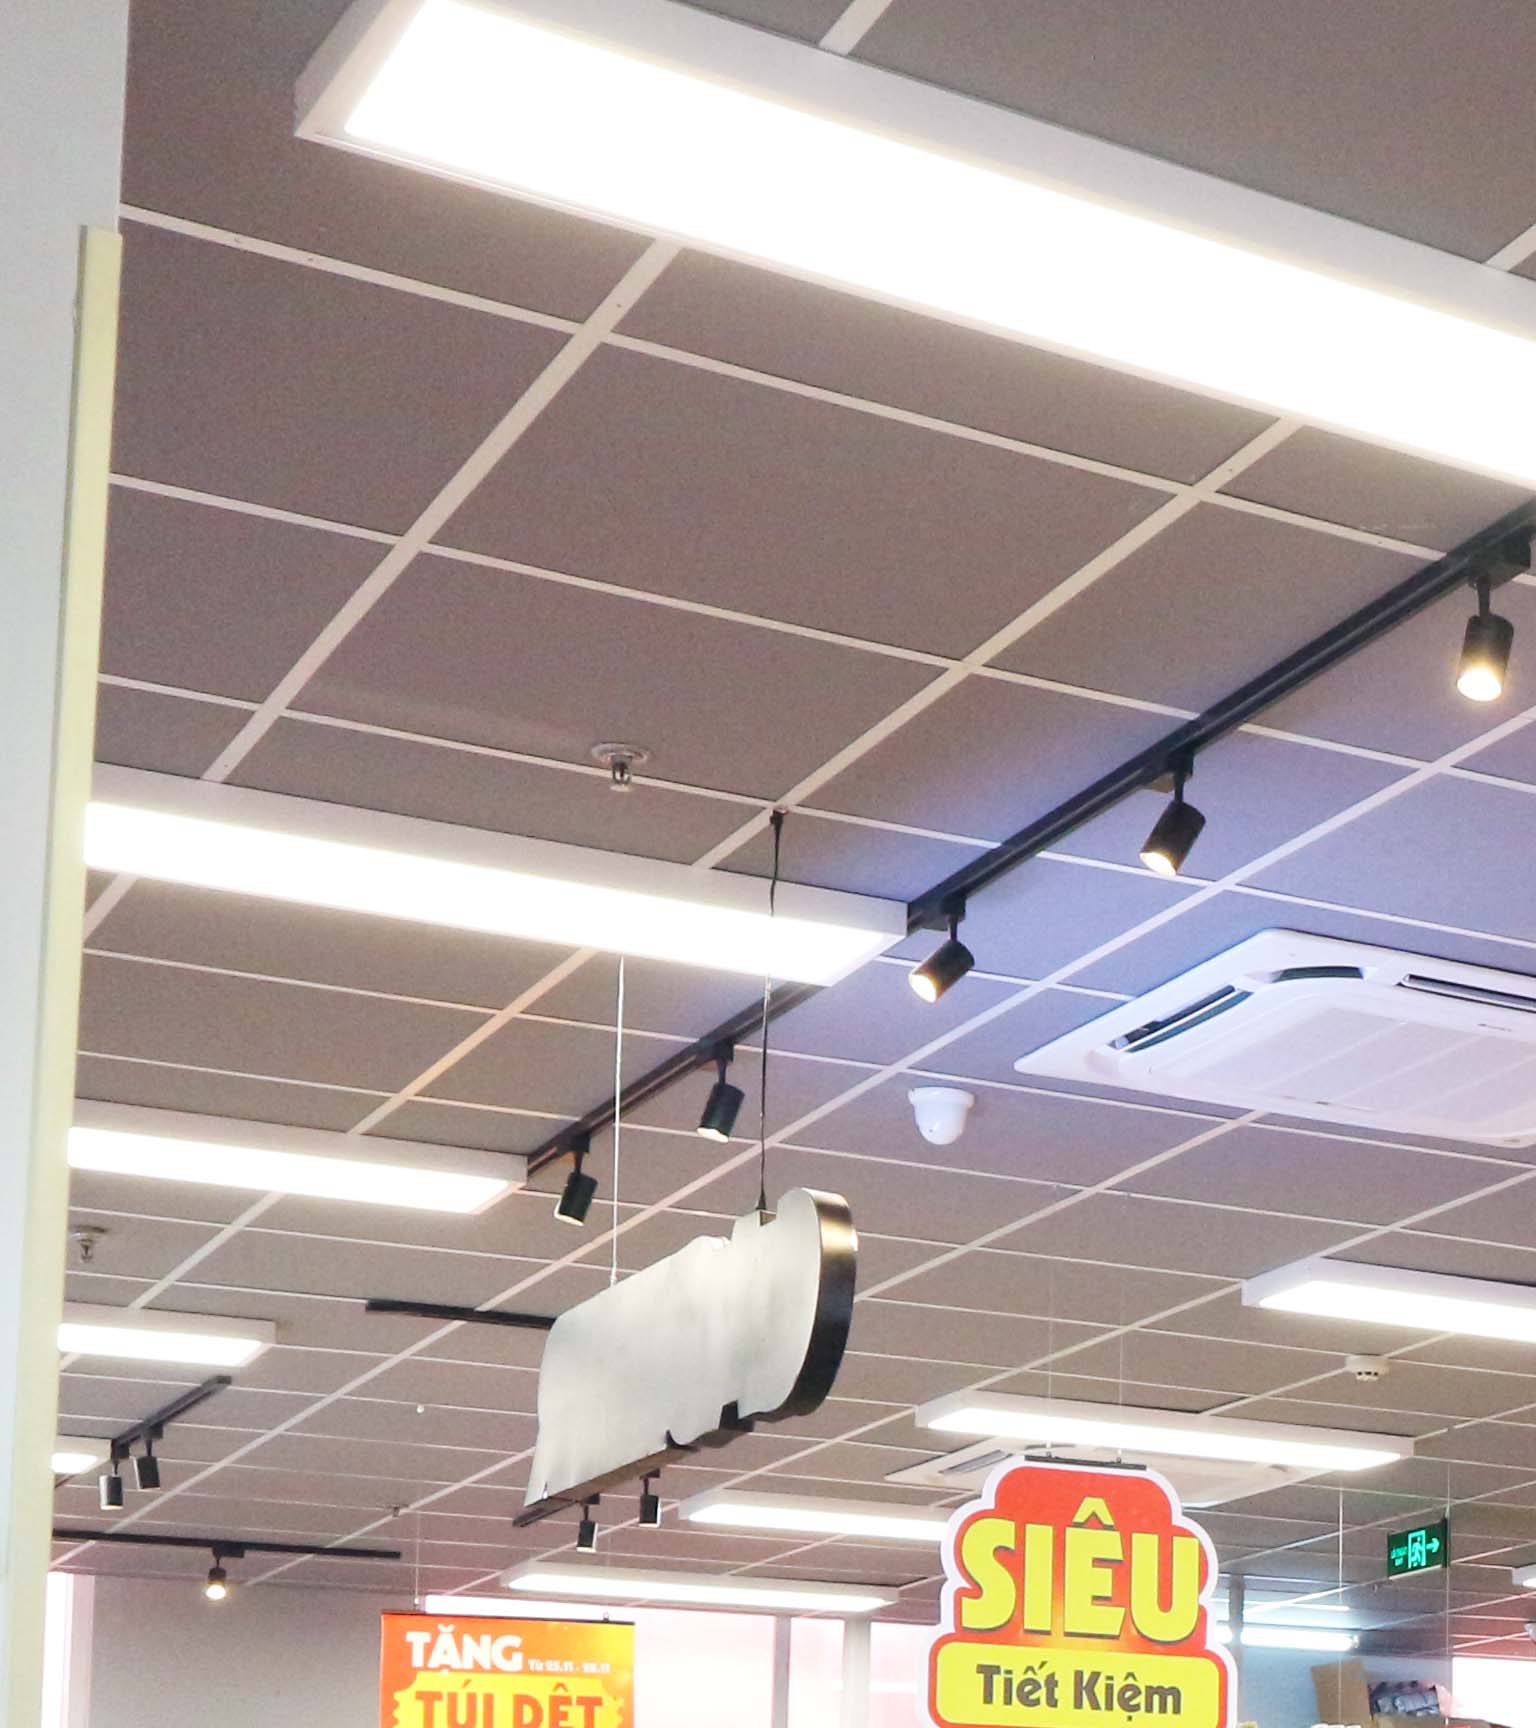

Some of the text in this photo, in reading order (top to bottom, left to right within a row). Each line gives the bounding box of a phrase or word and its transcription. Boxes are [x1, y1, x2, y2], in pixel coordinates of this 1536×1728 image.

[961, 1497, 1200, 1643] SIÊU
[406, 1624, 523, 1676] TẶNG
[976, 1661, 1181, 1721] Tiết Kiệm
